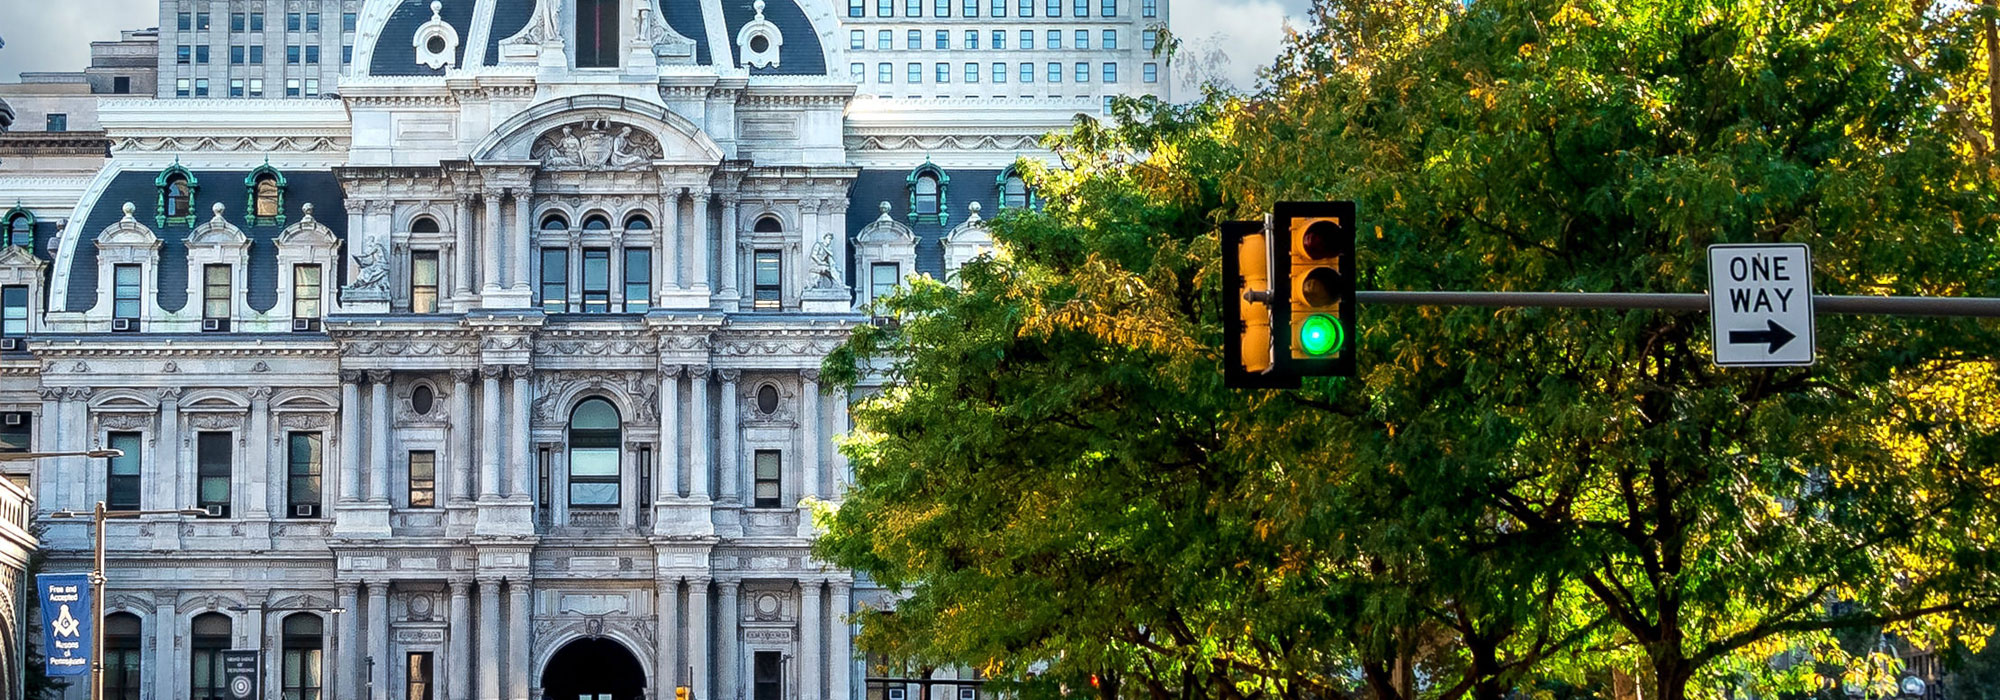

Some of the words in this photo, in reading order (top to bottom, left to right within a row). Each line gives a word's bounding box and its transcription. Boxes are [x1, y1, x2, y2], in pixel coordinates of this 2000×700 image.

[1730, 256, 1790, 282] ONE
[1729, 287, 1794, 313] WAY
[49, 585, 64, 594] Free
[65, 585, 78, 594] and
[49, 593, 78, 603] Accepted
